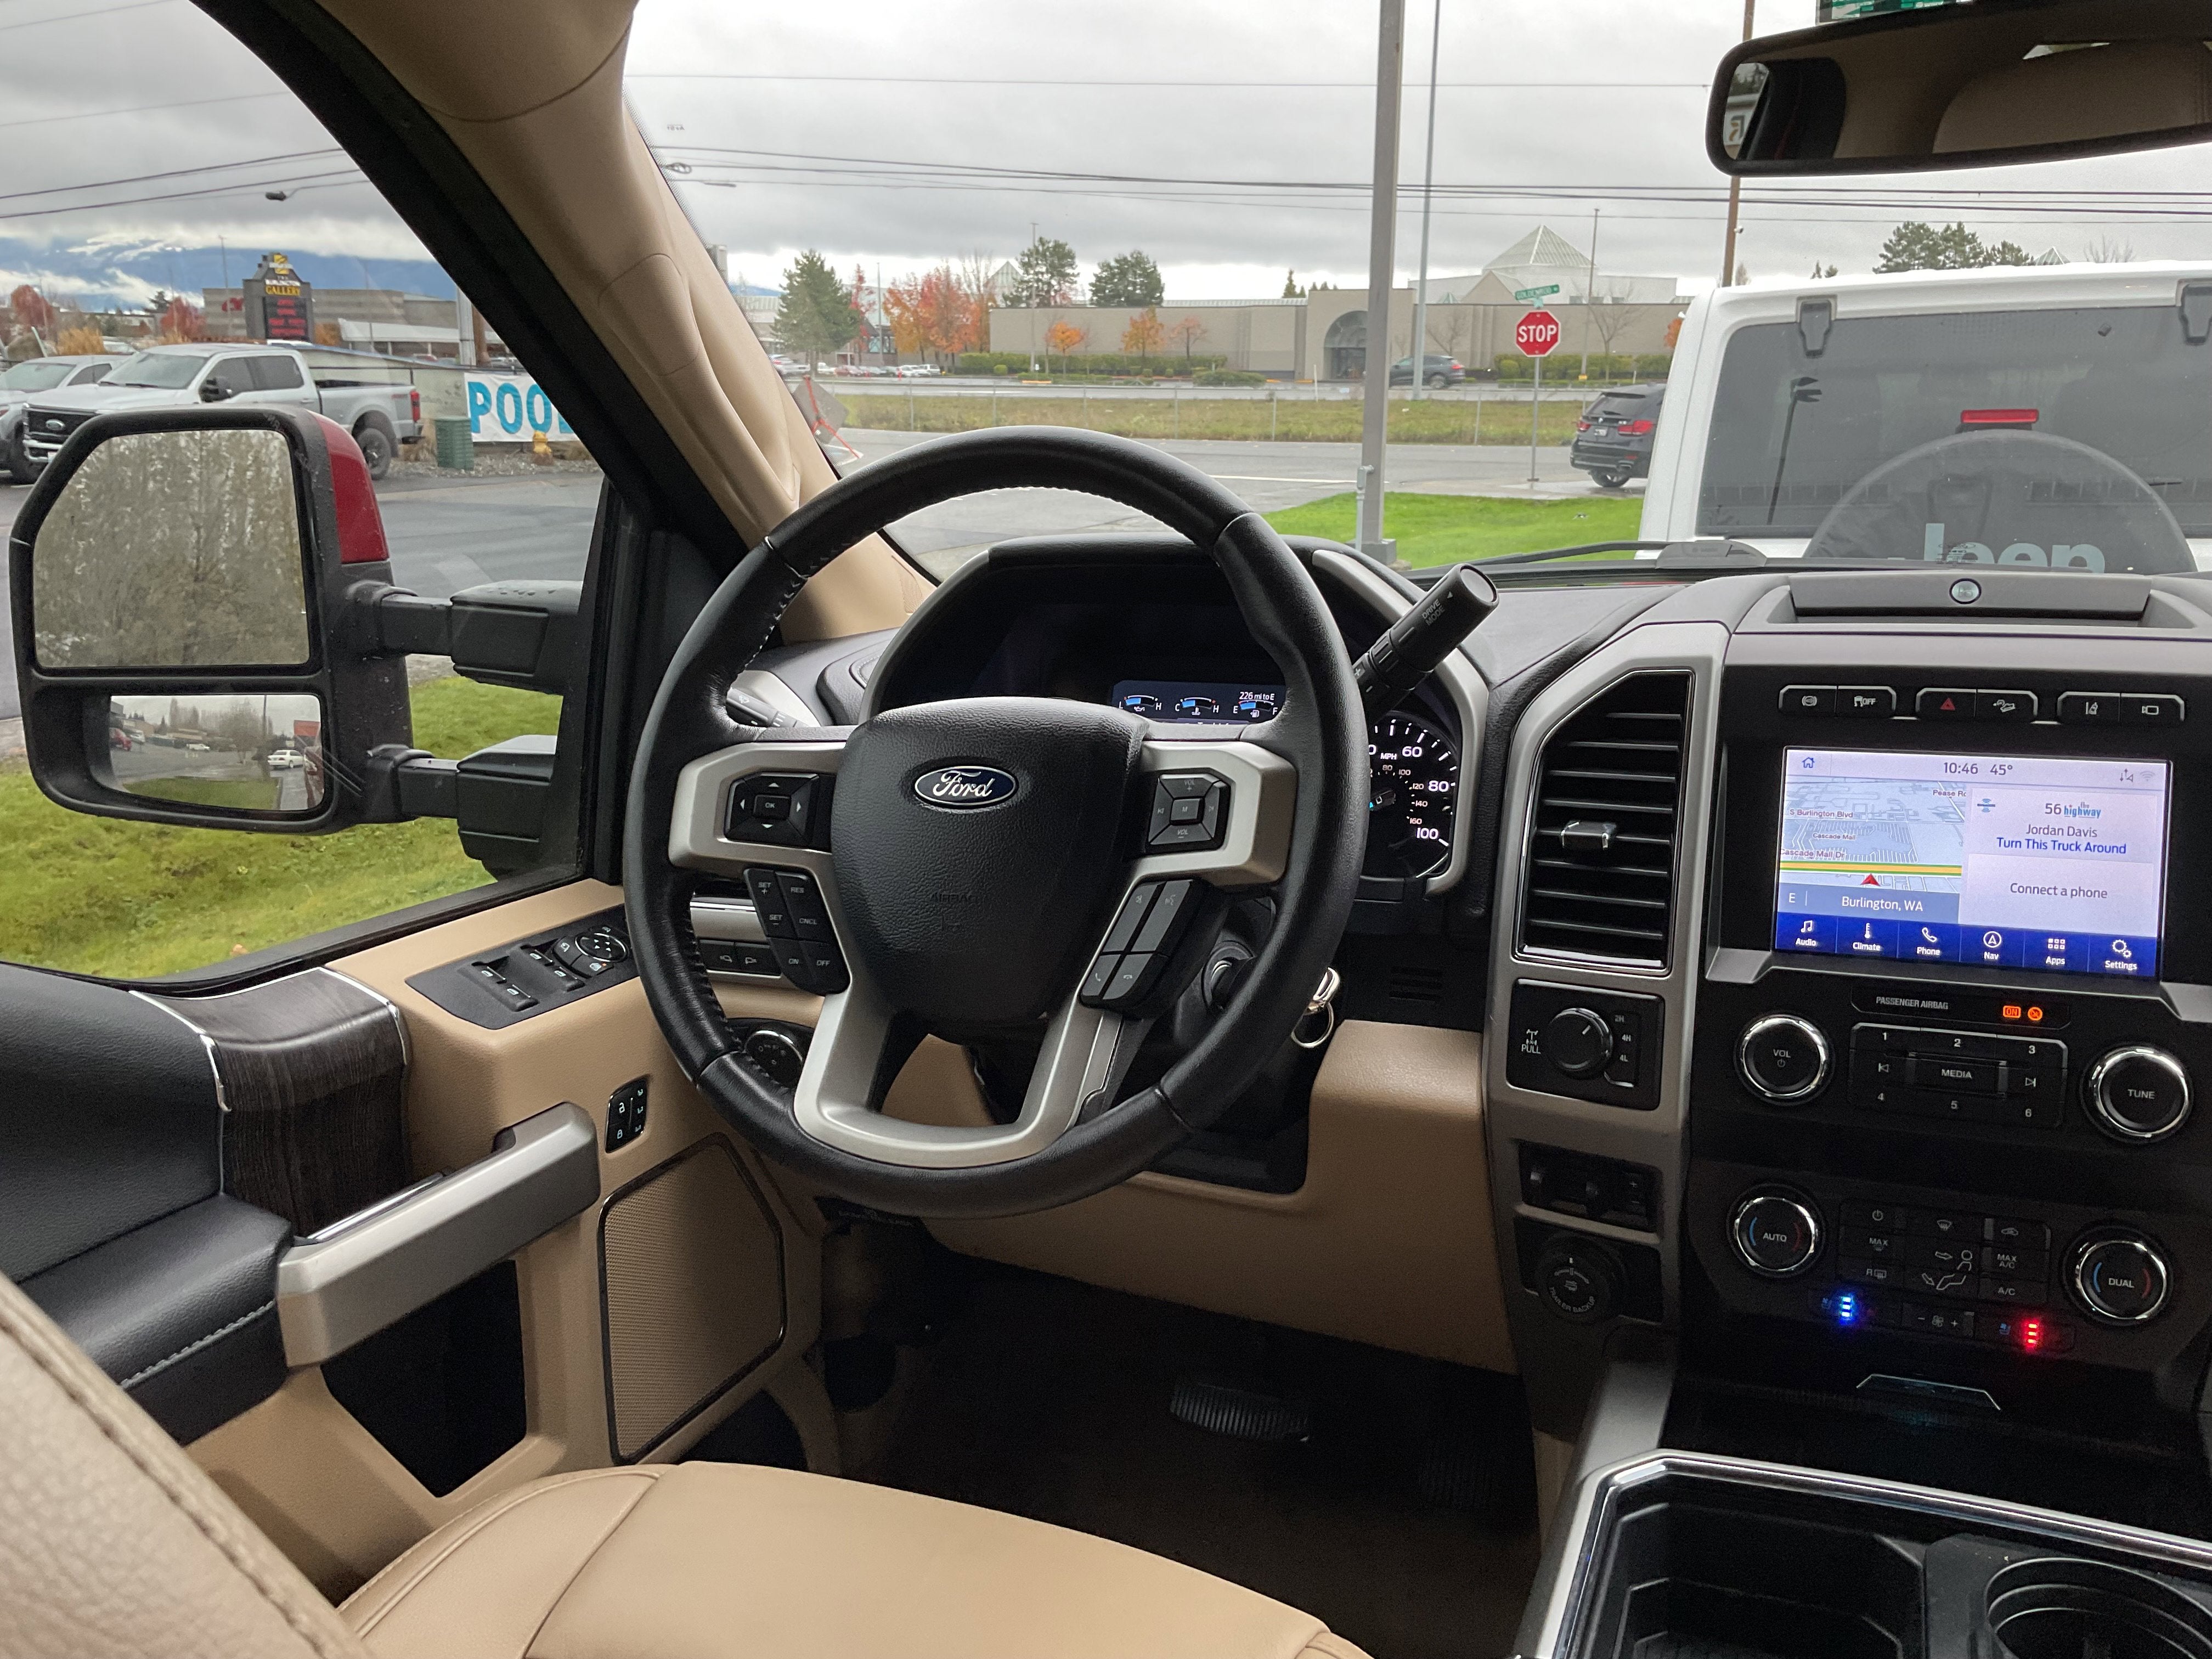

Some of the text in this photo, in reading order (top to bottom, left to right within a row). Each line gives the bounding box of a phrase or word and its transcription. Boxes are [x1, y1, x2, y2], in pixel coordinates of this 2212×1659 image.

[1518, 325, 1557, 343] STOP
[468, 381, 574, 434] POO
[1421, 599, 1441, 619] DRIVE
[1425, 606, 1445, 627] MODE
[1239, 692, 1253, 700] 226
[1863, 697, 1876, 706] OFF
[1233, 706, 1238, 714] E
[1402, 746, 1423, 758] 60
[1944, 762, 2013, 776] 10:46 45°
[932, 769, 996, 798] Ford
[1428, 780, 1449, 792] 80
[1797, 809, 1835, 818] Burlington
[2045, 803, 2102, 819] 56 highway
[1417, 827, 1439, 839] 100
[2026, 824, 2098, 838] Jordan Davis
[1996, 837, 2126, 854] Turn This Truck Around
[1780, 848, 1814, 857] Cascade
[2010, 882, 2108, 899] Connect a phone
[1788, 893, 1796, 904] E
[1842, 896, 1923, 912] Burlington, WA
[1796, 938, 1817, 947] Audio
[1852, 941, 1881, 951] Climate
[1916, 946, 1941, 956] Phone
[1984, 951, 1999, 961] Nav
[2045, 956, 2066, 966] Apps
[2104, 960, 2138, 971] Settings
[1876, 996, 1949, 1010] PASSENGER AIRBAG
[2006, 1008, 2019, 1016] ON
[1882, 1032, 1887, 1041] 1
[1954, 1039, 1961, 1047] 2
[1521, 1043, 1541, 1054] PULL
[1773, 1049, 1791, 1058] VOL
[2028, 1046, 2036, 1054] 3
[1941, 1069, 1973, 1080] MEDIA
[1877, 1092, 1885, 1101] 4
[2128, 1089, 2155, 1099] TUNE
[1950, 1101, 1958, 1109] 5
[2025, 1109, 2032, 1118] 6
[1763, 1233, 1787, 1242] AUTO
[1869, 1238, 1888, 1247] MAX
[1997, 1254, 2017, 1262] MAX
[1999, 1261, 2015, 1269] A/C
[2108, 1278, 2135, 1288] DUAL
[1998, 1288, 2016, 1296] A/C
